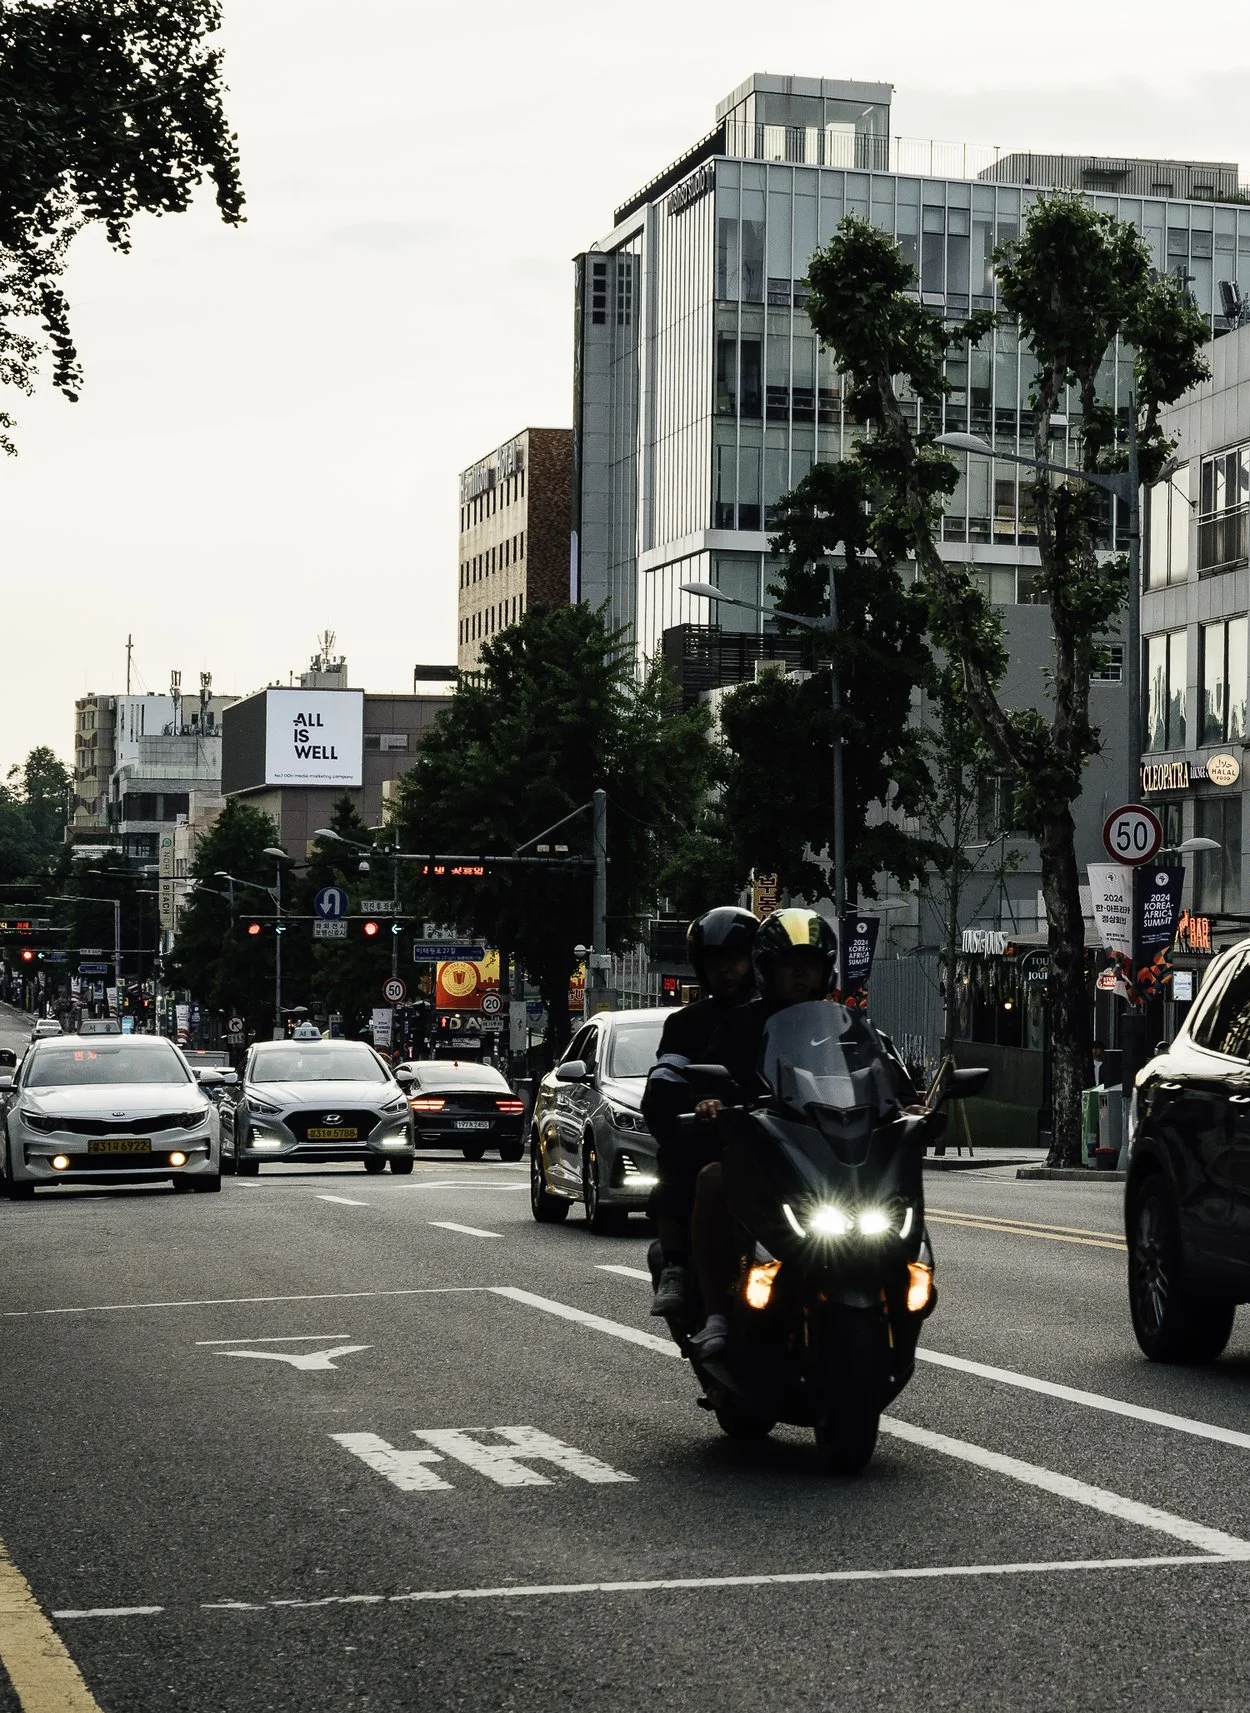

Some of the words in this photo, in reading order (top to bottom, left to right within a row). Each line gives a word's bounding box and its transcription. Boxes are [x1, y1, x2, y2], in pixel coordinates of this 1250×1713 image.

[293, 713, 324, 727] ALL
[294, 729, 310, 743] IS
[294, 745, 338, 760] WELL
[1143, 762, 1189, 792] CLEOPATRA
[1211, 768, 1236, 776] HALAL
[1117, 821, 1148, 851] 50
[162, 884, 171, 915] BEACH
[758, 873, 778, 919] 부동
[1103, 894, 1124, 903] 2024
[1150, 893, 1171, 903] 2024
[1095, 904, 1131, 915] 한·아프리카
[1144, 902, 1174, 911] KOREA-
[1101, 915, 1127, 925] 정상회의
[1143, 910, 1173, 920] AFRICA
[1143, 917, 1173, 928] SUMMIT
[1189, 917, 1209, 948] BAR
[848, 945, 871, 953] KOREA-
[961, 929, 979, 954] TOUS
[984, 931, 1008, 960] JOURS
[848, 951, 870, 959] AFRICA
[848, 957, 870, 966] SUMMIT
[1031, 957, 1050, 966] TOU
[388, 985, 401, 996] 50
[485, 999, 499, 1009] 20
[121, 1141, 147, 1151] 6922
